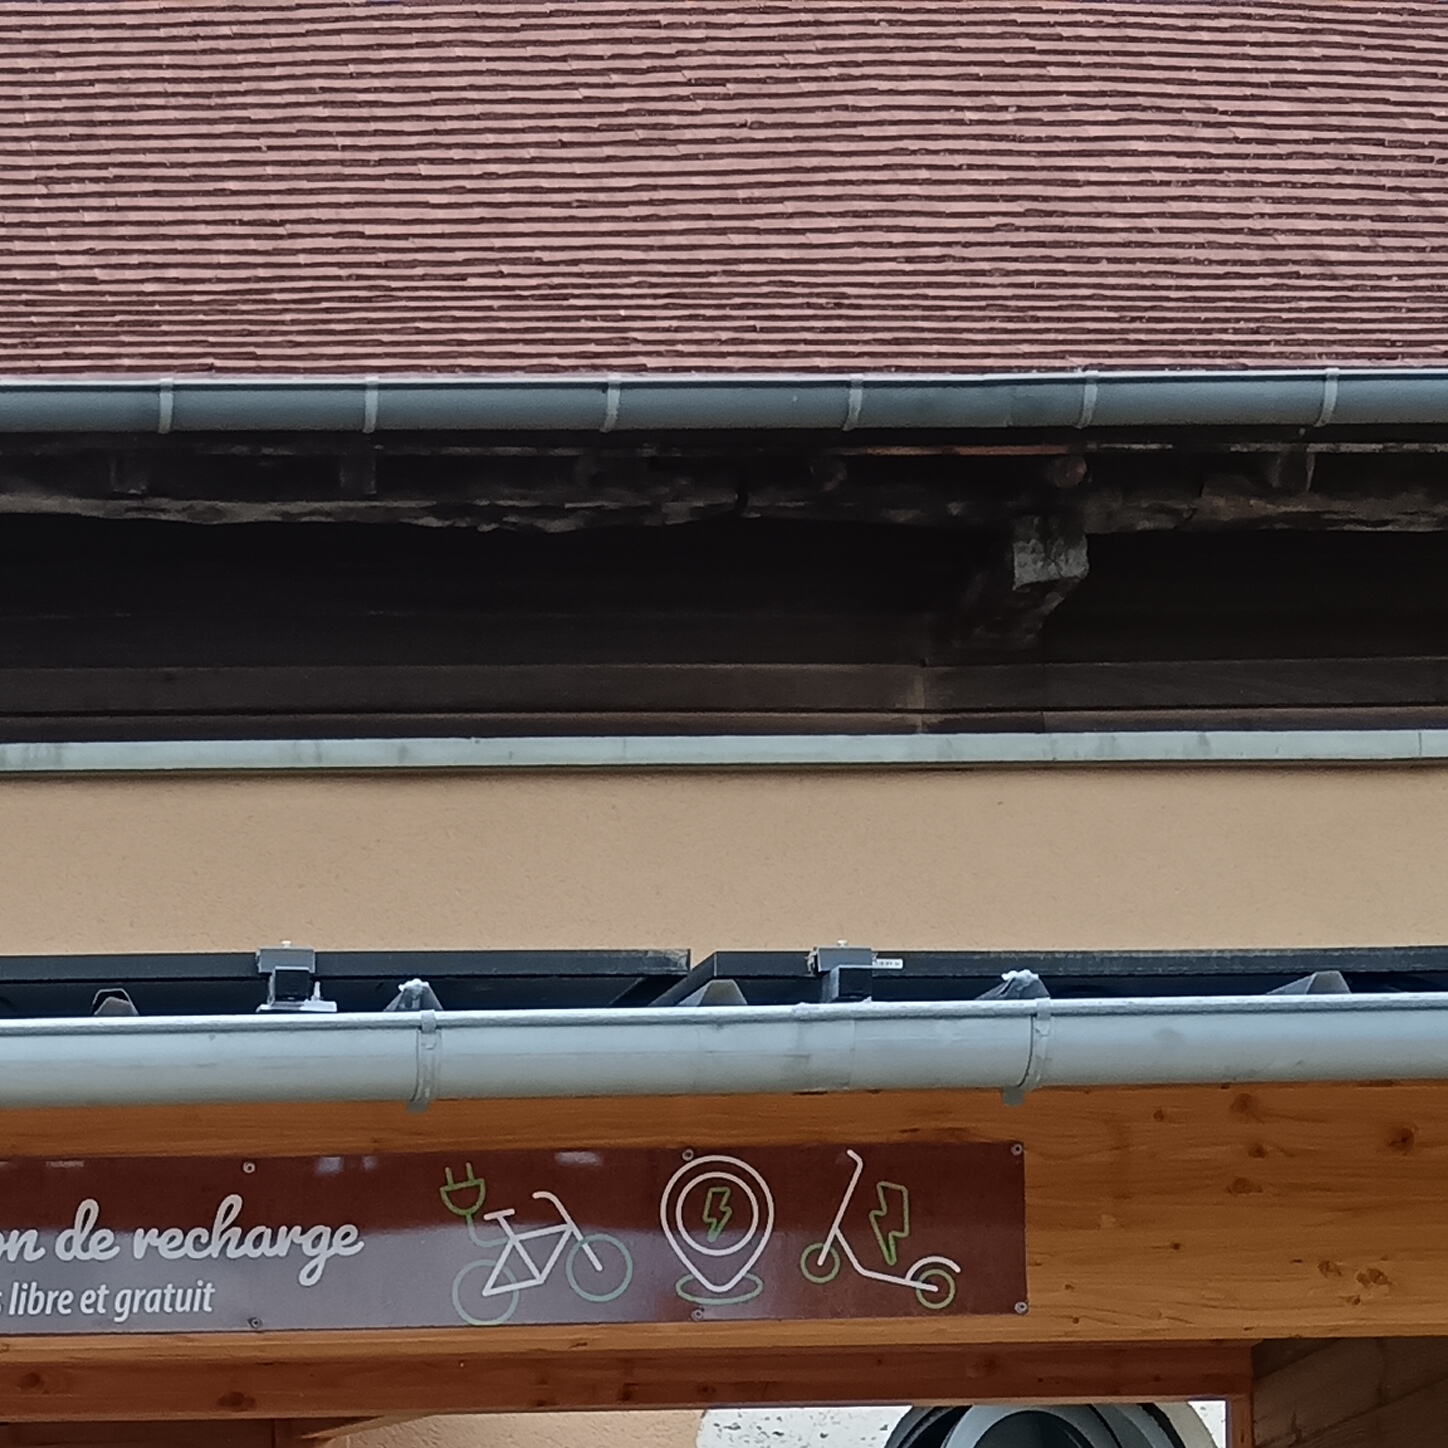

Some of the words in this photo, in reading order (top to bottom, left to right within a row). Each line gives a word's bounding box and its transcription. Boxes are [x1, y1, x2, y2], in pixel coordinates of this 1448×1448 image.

[55, 1198, 121, 1262] de
[131, 1193, 366, 1286] recharge
[7, 1281, 74, 1317] libre
[79, 1283, 109, 1314] et
[114, 1279, 216, 1323] gratuit
